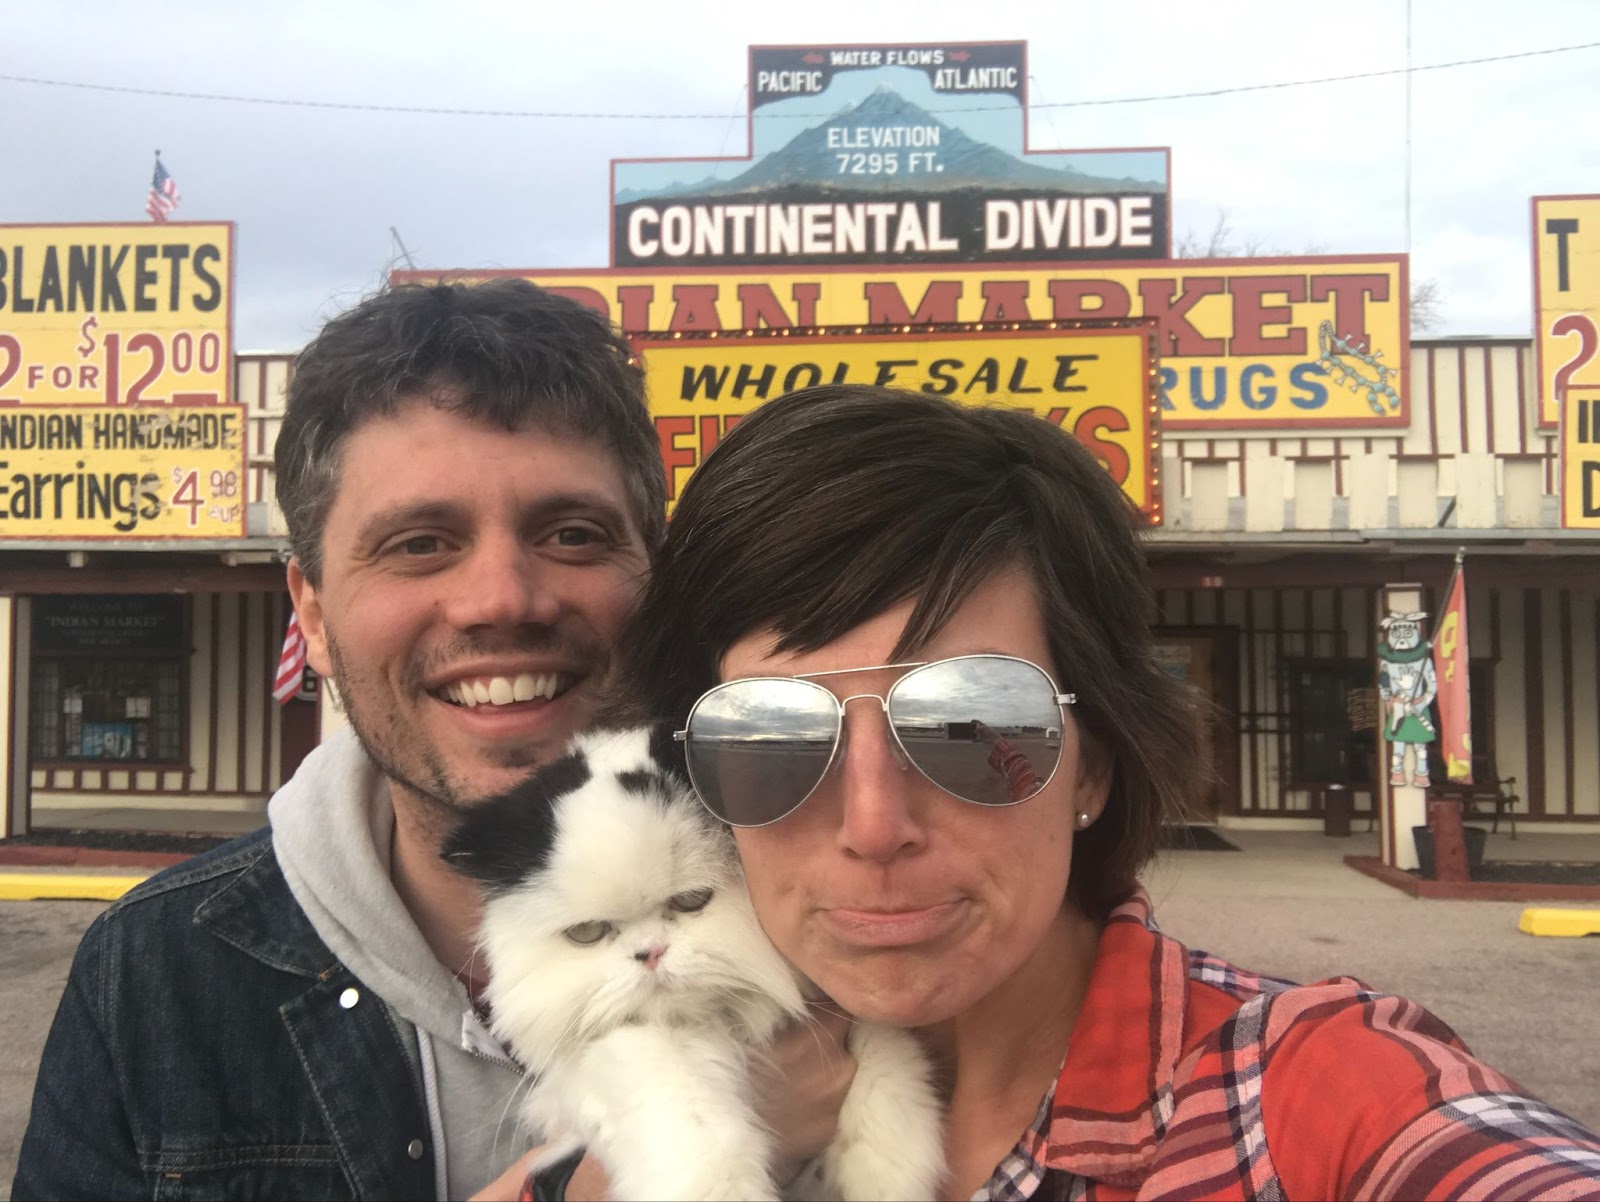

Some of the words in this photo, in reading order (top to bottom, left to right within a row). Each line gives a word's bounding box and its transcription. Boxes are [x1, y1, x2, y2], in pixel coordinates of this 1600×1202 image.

[831, 51, 880, 65] WATER
[887, 50, 945, 65] FLOWS
[757, 71, 822, 92] PACIFIC
[934, 67, 1018, 90] ATLANTIC
[827, 126, 940, 149] ELEVATION
[836, 153, 898, 175] 7295
[908, 152, 945, 173] FT.
[628, 201, 959, 257] CONTINENTAL
[984, 196, 1152, 254] DIVIDE
[1552, 315, 1598, 400] 2
[28, 365, 99, 390] FOR
[1159, 363, 1329, 411] RUGS
[0, 414, 82, 450] NDIAN
[94, 413, 236, 450] HANDMADE
